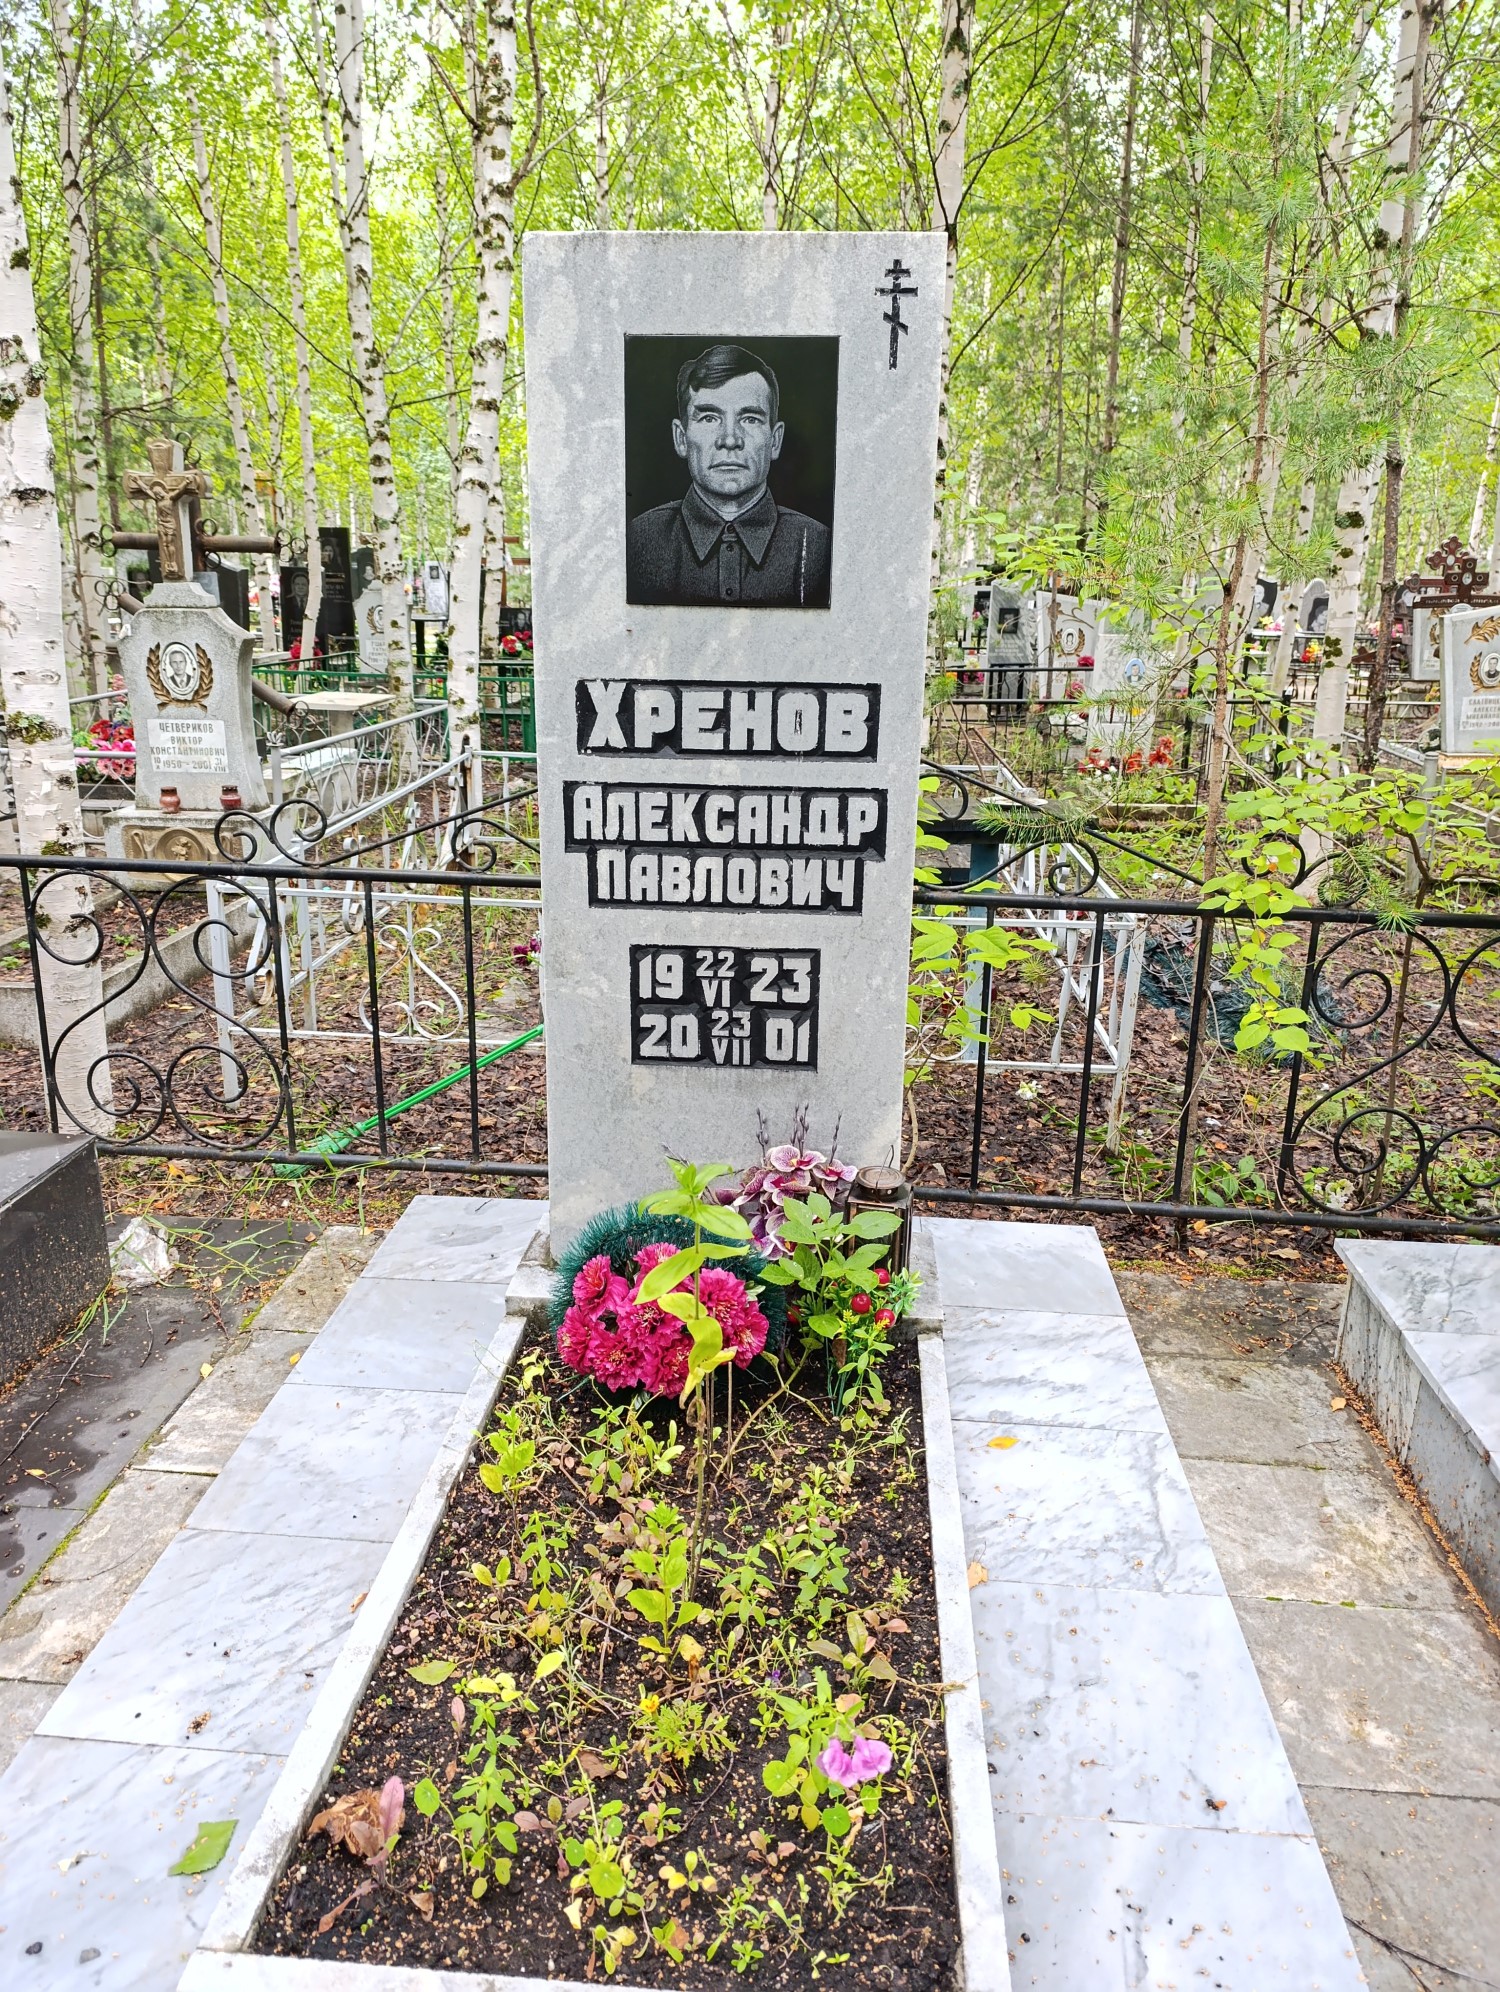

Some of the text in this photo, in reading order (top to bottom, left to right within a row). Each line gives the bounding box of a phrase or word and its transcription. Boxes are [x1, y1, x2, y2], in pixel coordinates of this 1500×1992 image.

[159, 722, 214, 733] ЧЕТВЕРИКОВ
[585, 681, 870, 752] ХРЕНОВ
[150, 746, 225, 756] КОНСТАНТИНОВИЧ
[170, 736, 203, 745] ВИКТОР
[573, 785, 879, 846] АЛЕКСАНДР
[597, 849, 857, 907] ПАВЛОВИЧ
[639, 951, 811, 1004] 19 23
[696, 950, 735, 977] 22
[700, 979, 731, 1008] VI
[639, 1013, 810, 1062] 20 01
[711, 1010, 751, 1037] 23
[711, 1038, 751, 1066] VII
